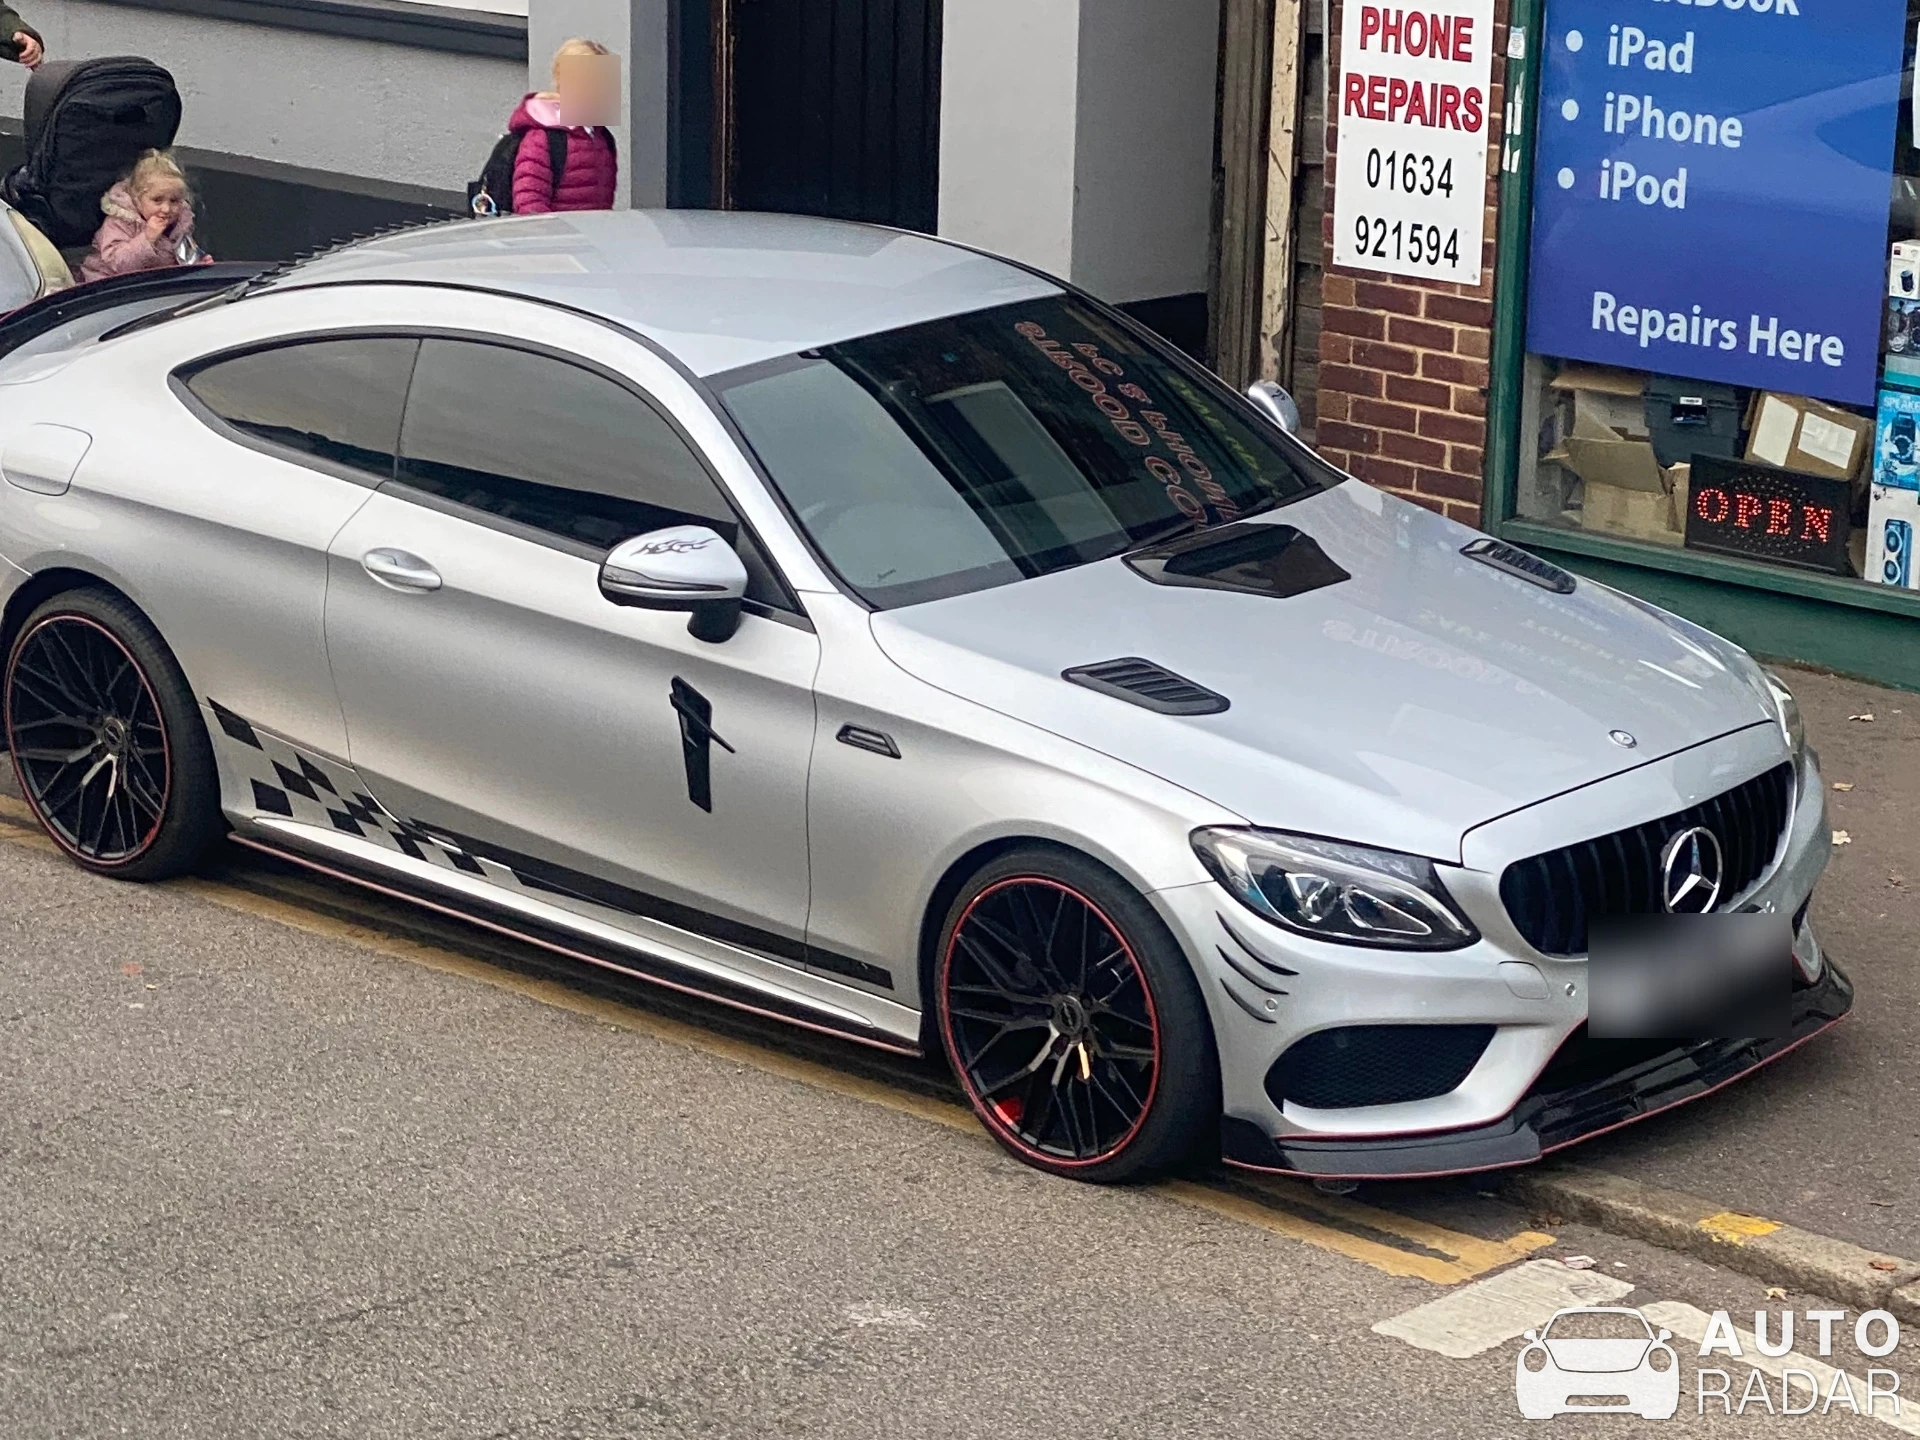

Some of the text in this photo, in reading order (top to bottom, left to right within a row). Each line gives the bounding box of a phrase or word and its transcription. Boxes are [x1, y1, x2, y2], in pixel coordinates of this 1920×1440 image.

[1360, 6, 1474, 62] PHONE
[1608, 24, 1694, 73] iPad
[1344, 73, 1483, 132] REPAIRS
[1604, 91, 1743, 148] iPhone
[1366, 148, 1453, 198] 01634
[1599, 158, 1687, 209] iPod
[1354, 215, 1460, 268] 921594
[1592, 291, 1845, 367] Repairs Here
[1696, 488, 1832, 542] OPEN
